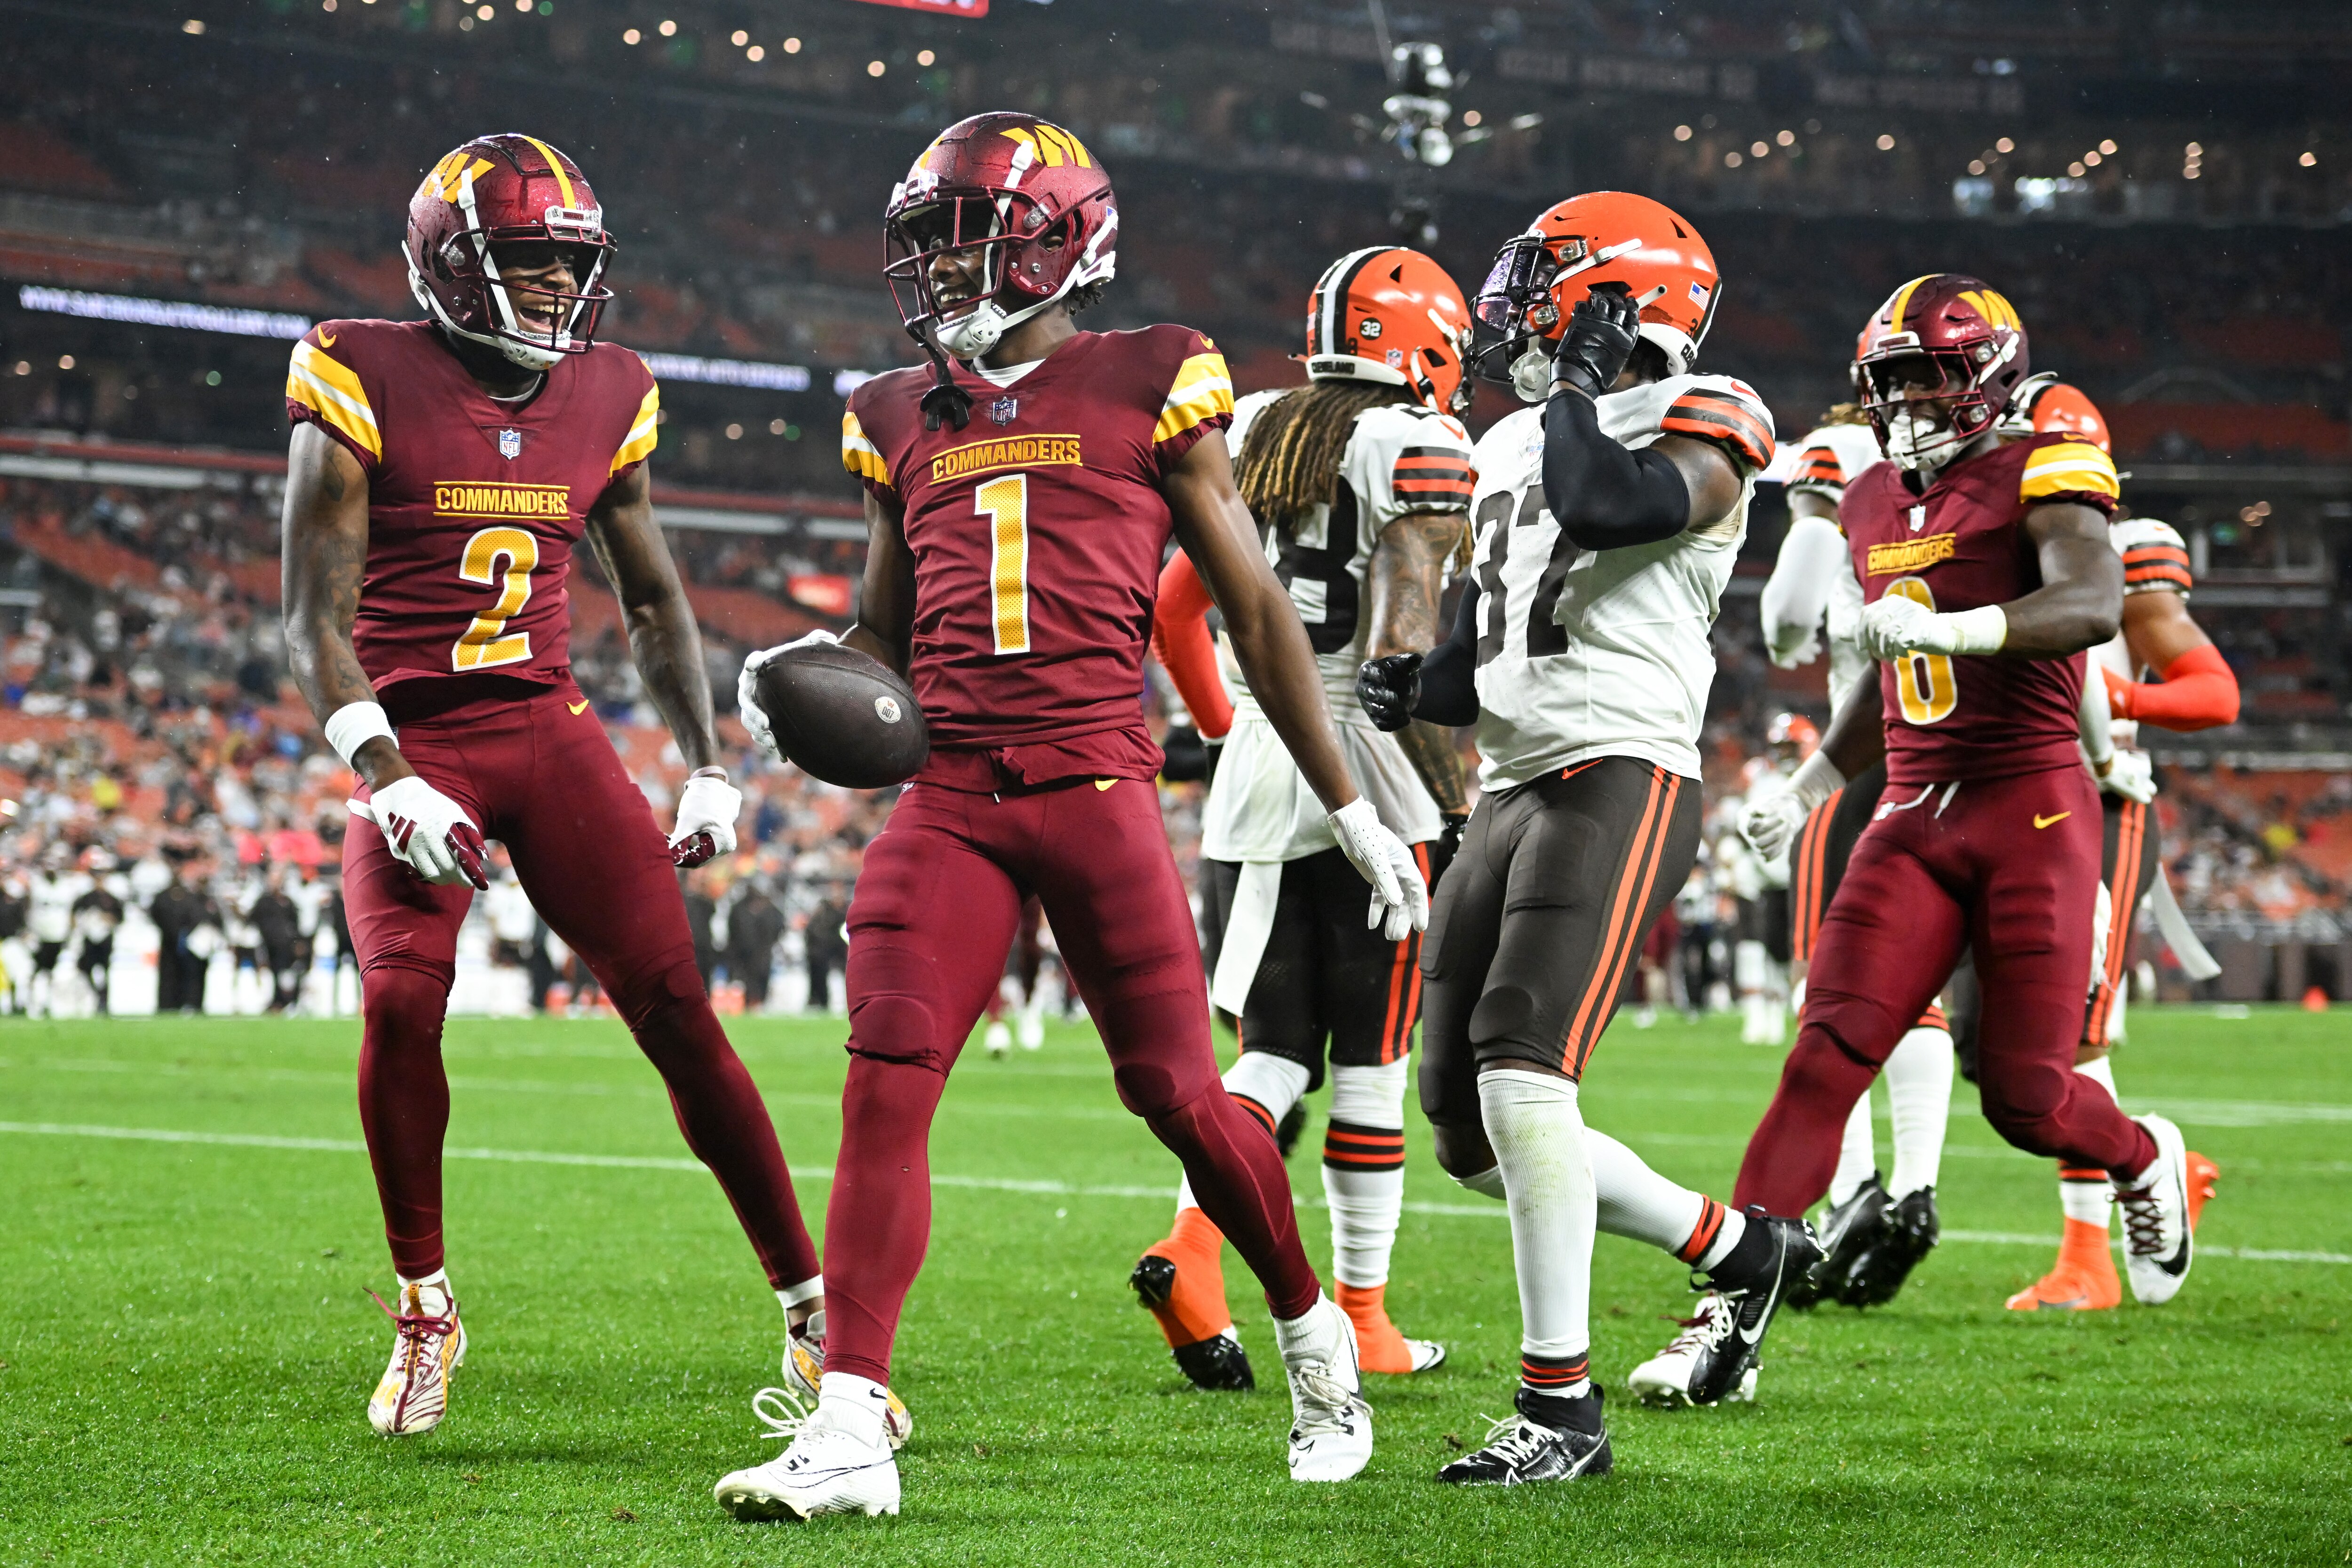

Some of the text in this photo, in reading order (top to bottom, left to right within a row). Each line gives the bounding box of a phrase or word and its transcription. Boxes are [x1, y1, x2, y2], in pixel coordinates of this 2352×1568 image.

[1360, 321, 1381, 337] 32
[503, 442, 516, 453] NFL
[933, 440, 1081, 480] COMMANDERS
[436, 487, 568, 514] COMMANDERS
[974, 473, 1031, 655] 1
[1867, 538, 1955, 571] COMMANDERS
[452, 526, 539, 672] 2
[882, 706, 894, 719] 007
